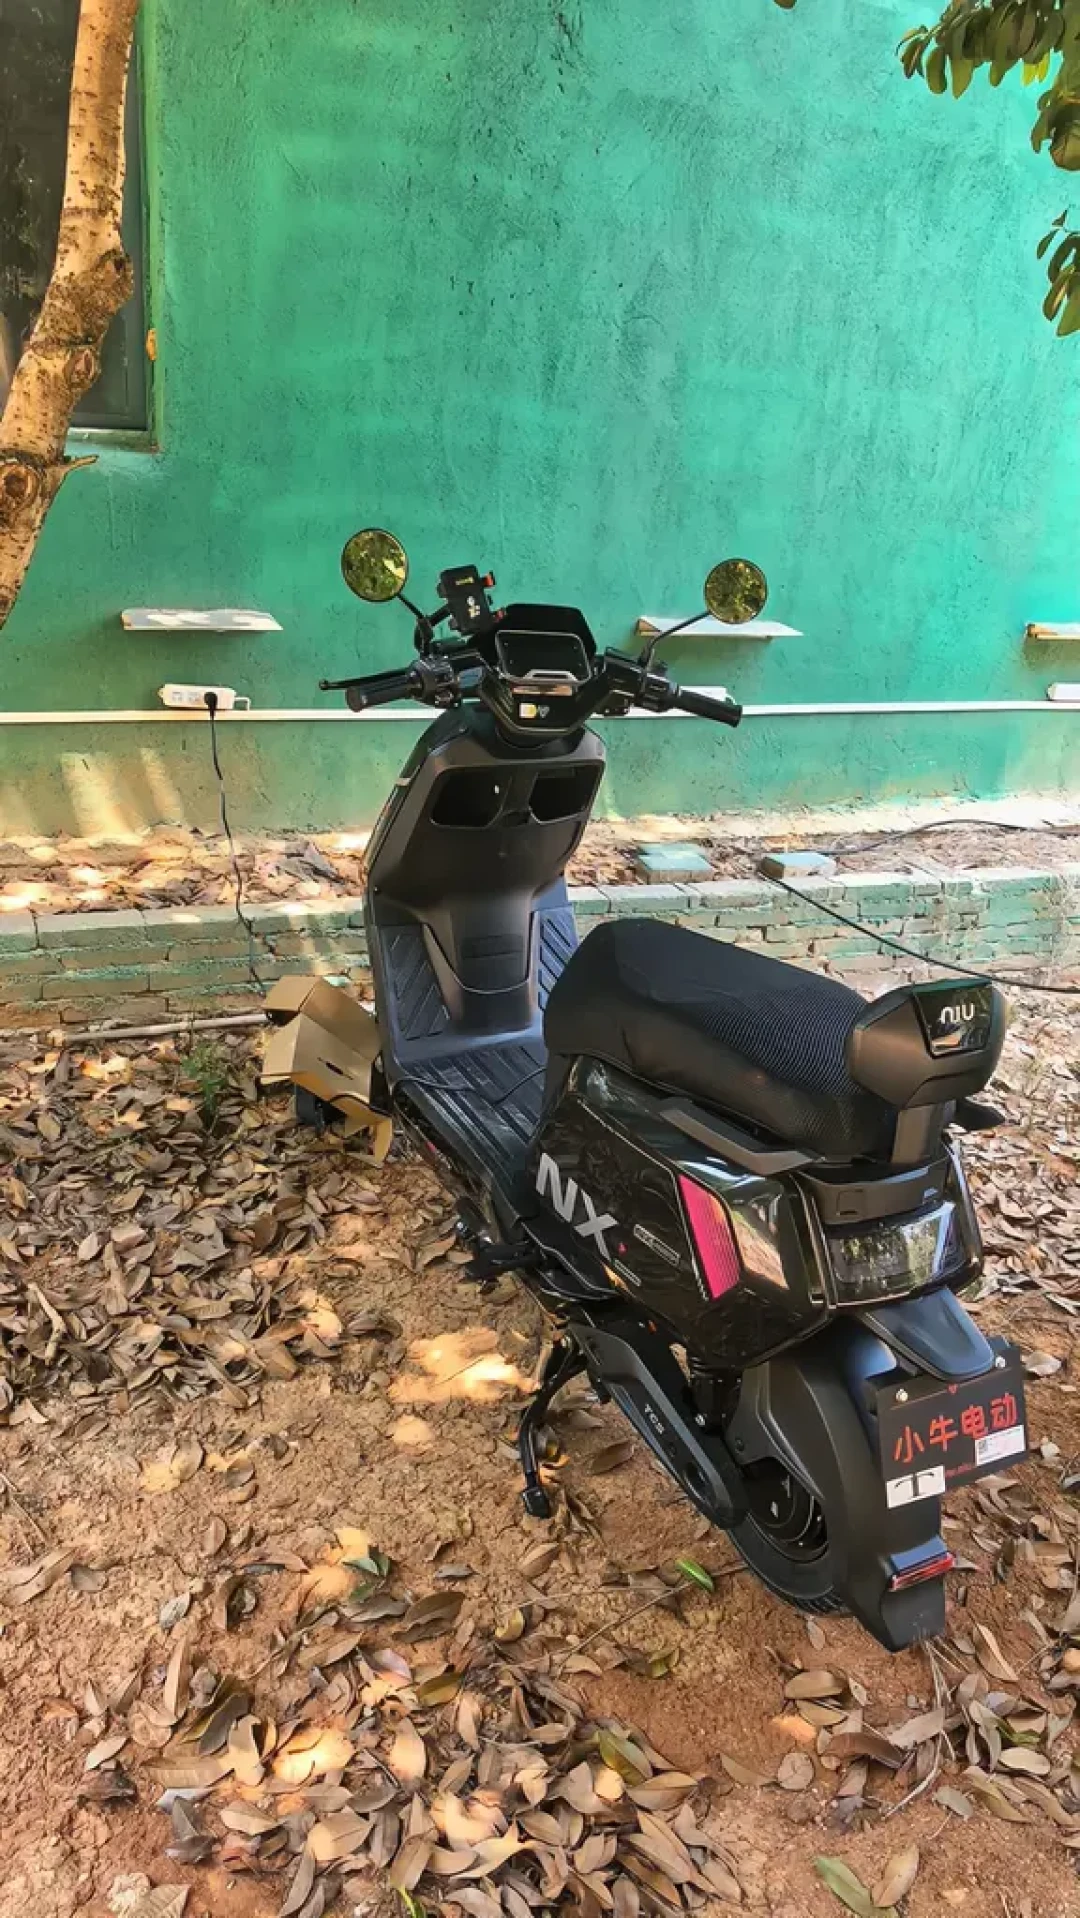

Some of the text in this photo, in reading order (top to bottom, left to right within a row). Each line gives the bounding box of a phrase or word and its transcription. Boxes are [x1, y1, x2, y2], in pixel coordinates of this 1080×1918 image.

[939, 1003, 975, 1024] NIU
[536, 1153, 618, 1262] NX
[645, 1404, 664, 1434] TCS
[894, 1393, 1017, 1463] 小牛电动
